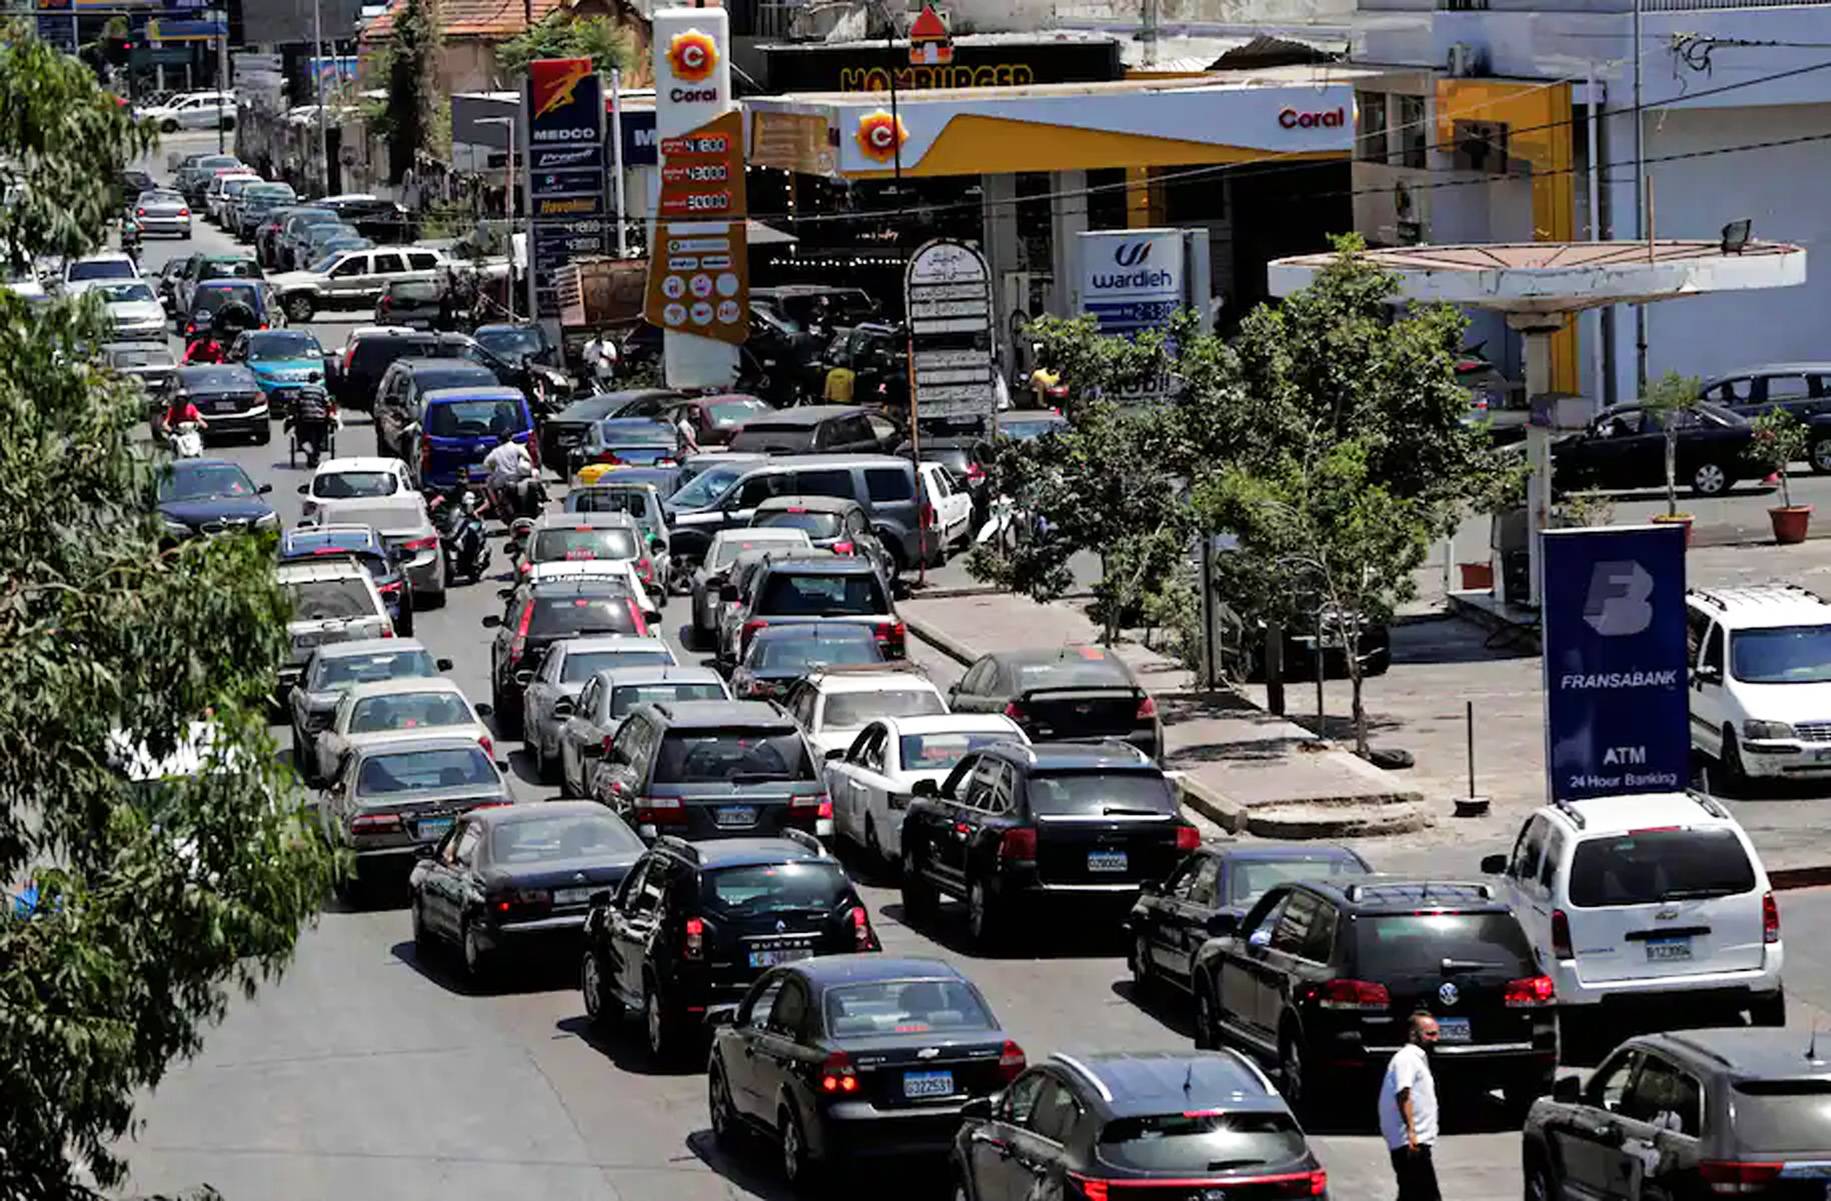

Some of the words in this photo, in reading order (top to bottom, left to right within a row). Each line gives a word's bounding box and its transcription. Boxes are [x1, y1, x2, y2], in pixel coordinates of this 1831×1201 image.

[670, 88, 717, 103] Coral
[1278, 106, 1345, 129] Coral
[534, 128, 595, 140] MEDCO
[1092, 269, 1172, 288] wardieh
[1561, 669, 1677, 689] FRANSABANK
[1603, 746, 1646, 765] ATM
[1570, 776, 1586, 788] 24
[1587, 774, 1621, 788] Hour
[1624, 772, 1678, 787] Banking
